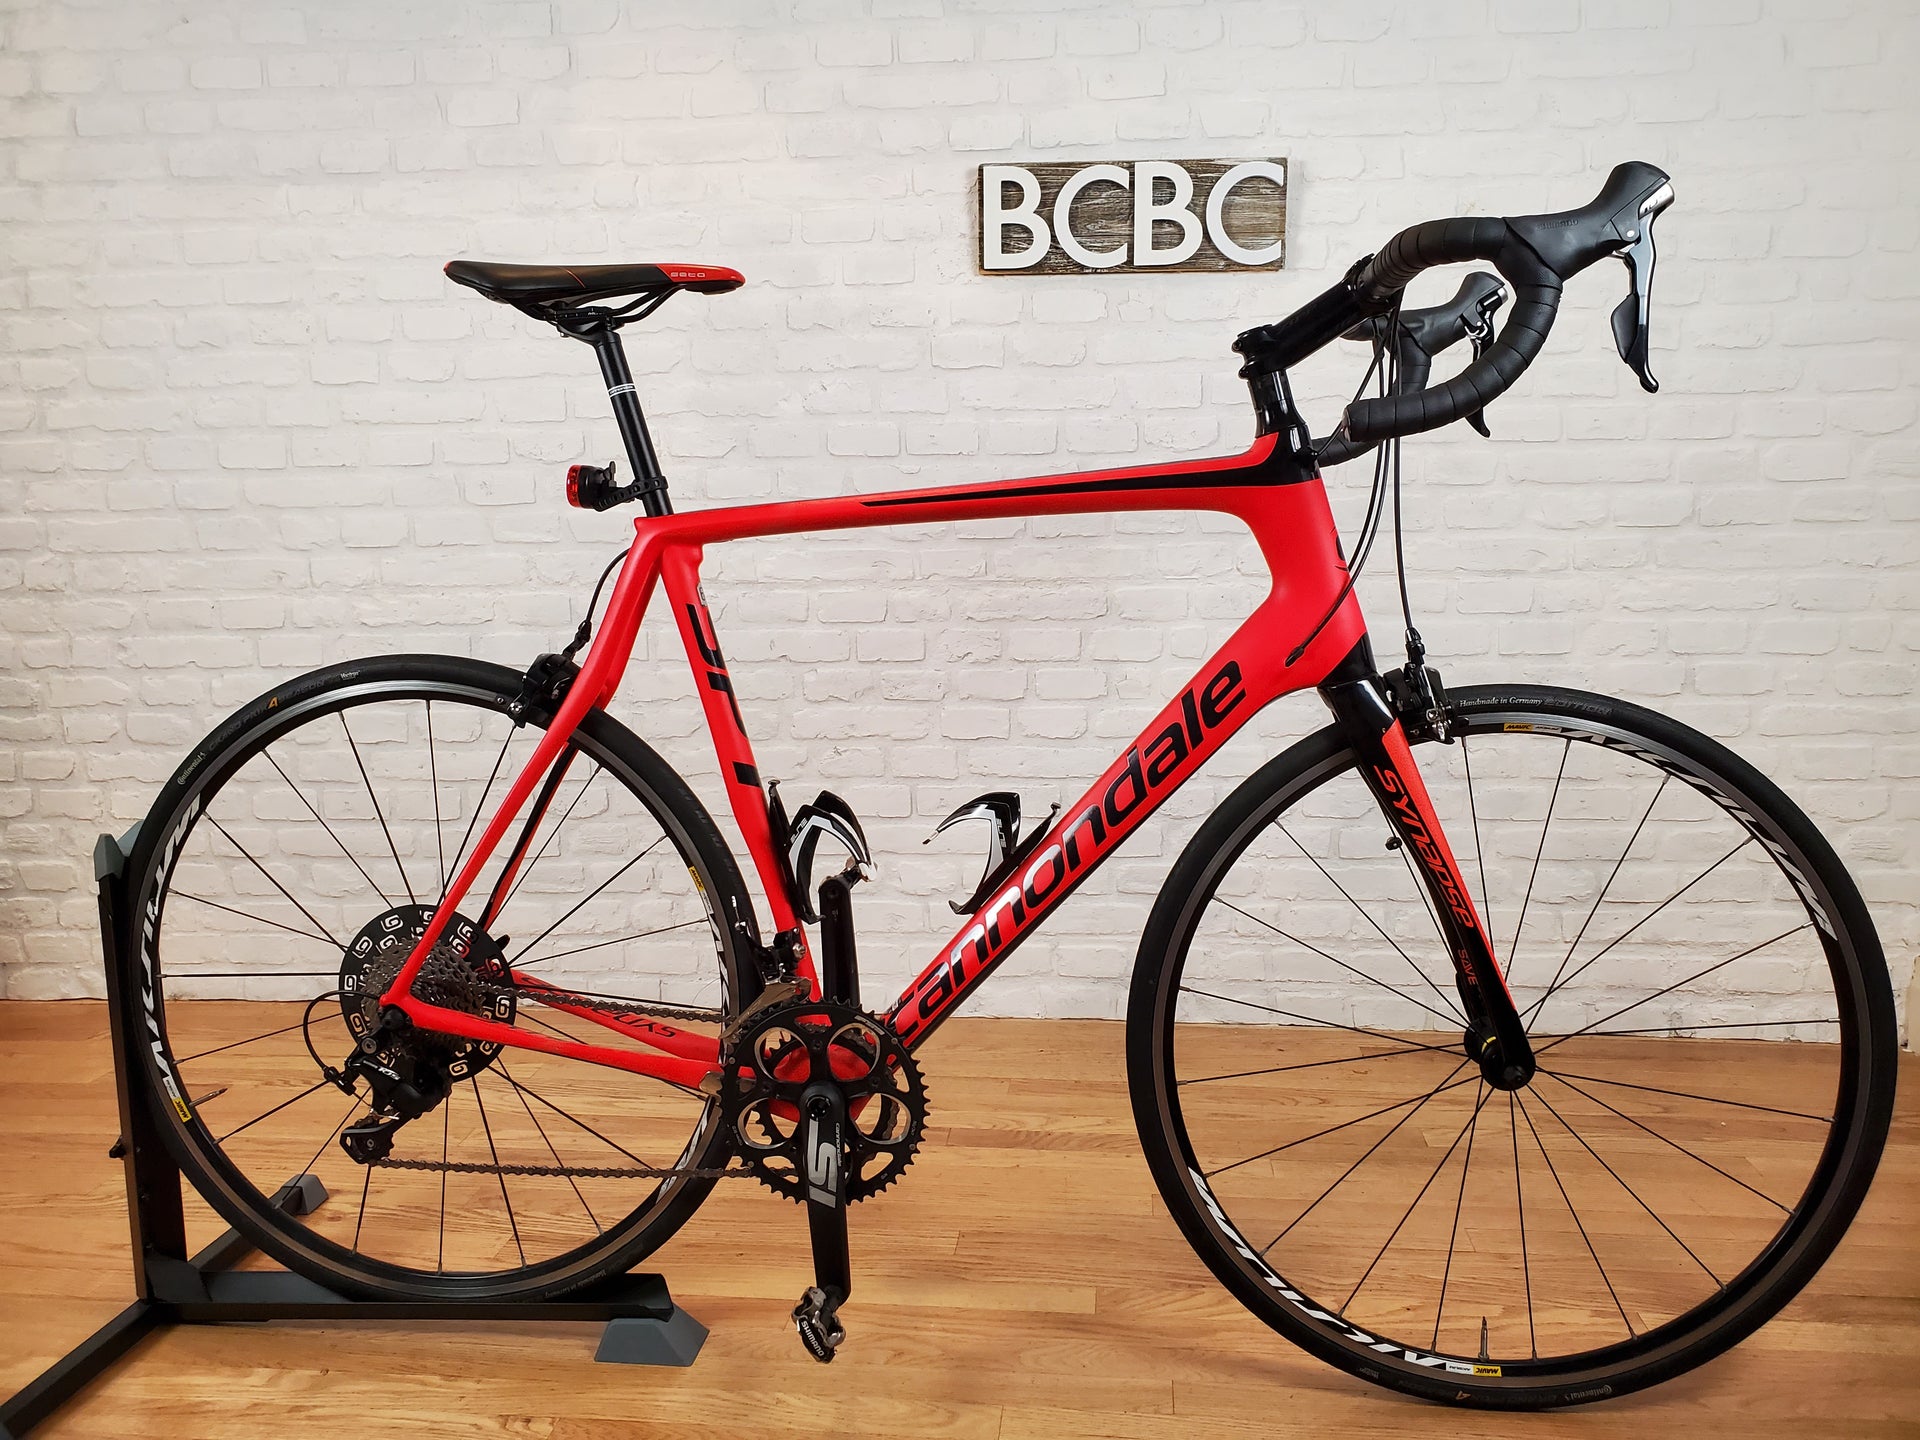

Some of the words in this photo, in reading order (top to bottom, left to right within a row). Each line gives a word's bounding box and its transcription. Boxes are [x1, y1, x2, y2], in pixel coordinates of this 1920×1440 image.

[983, 161, 1284, 269] BCBC
[1459, 696, 1500, 708] Handmade
[1500, 697, 1508, 705] in
[1509, 696, 1543, 707] Germany
[886, 660, 1247, 1037] cannondale
[1458, 949, 1478, 986] SAVE
[801, 1320, 825, 1357] SHIMANO
[1475, 1367, 1500, 1375] MAVIC
